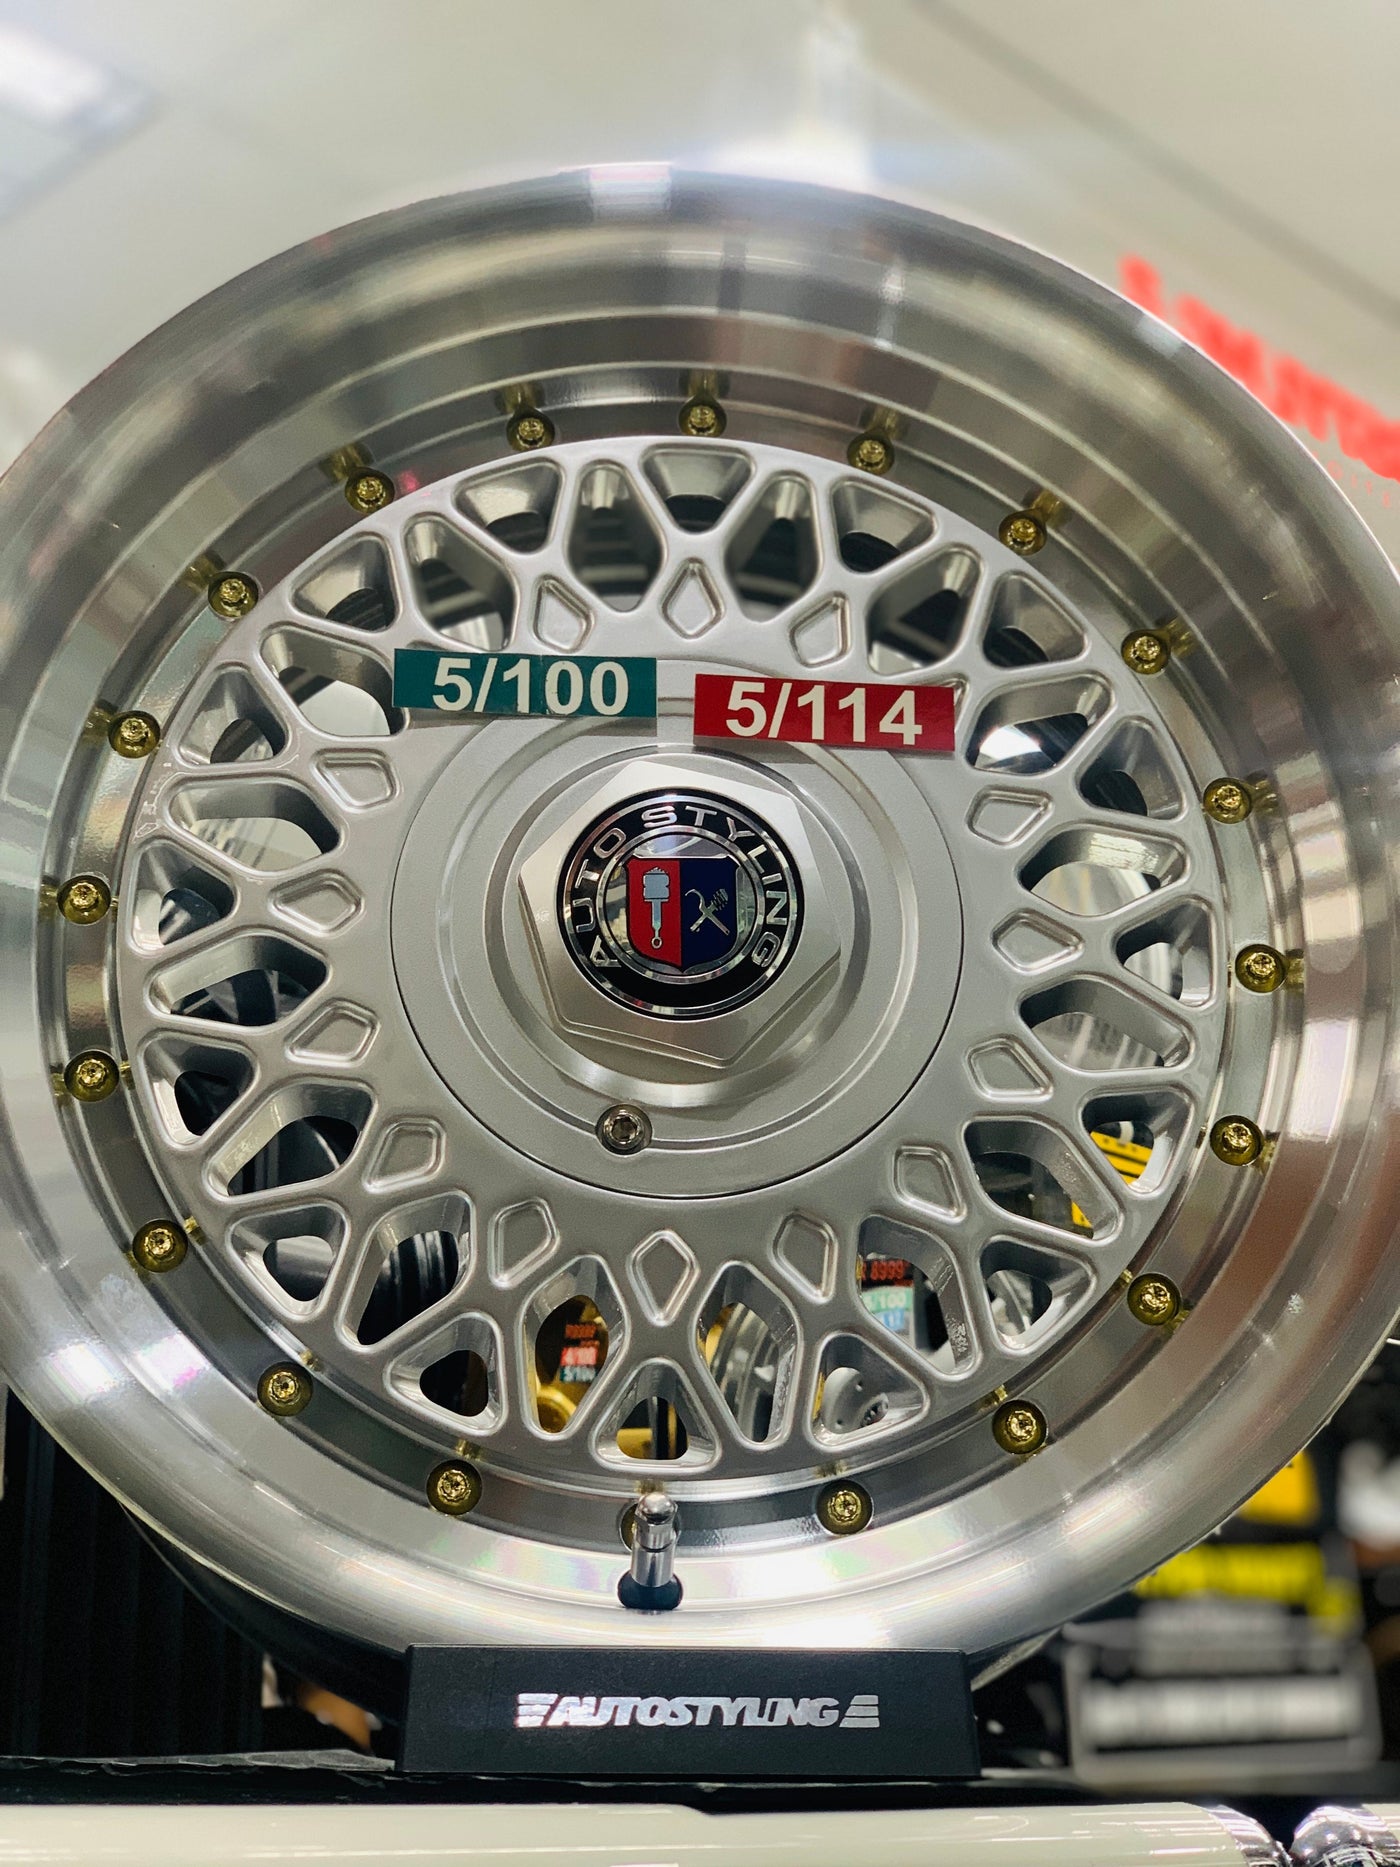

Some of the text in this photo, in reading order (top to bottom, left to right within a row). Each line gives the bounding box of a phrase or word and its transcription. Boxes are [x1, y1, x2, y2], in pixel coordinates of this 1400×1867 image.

[432, 657, 629, 716] 5/100
[726, 681, 923, 745] 5/114
[572, 805, 788, 968] AUTO STYLING
[546, 1695, 840, 1728] AUTOSTYLING
